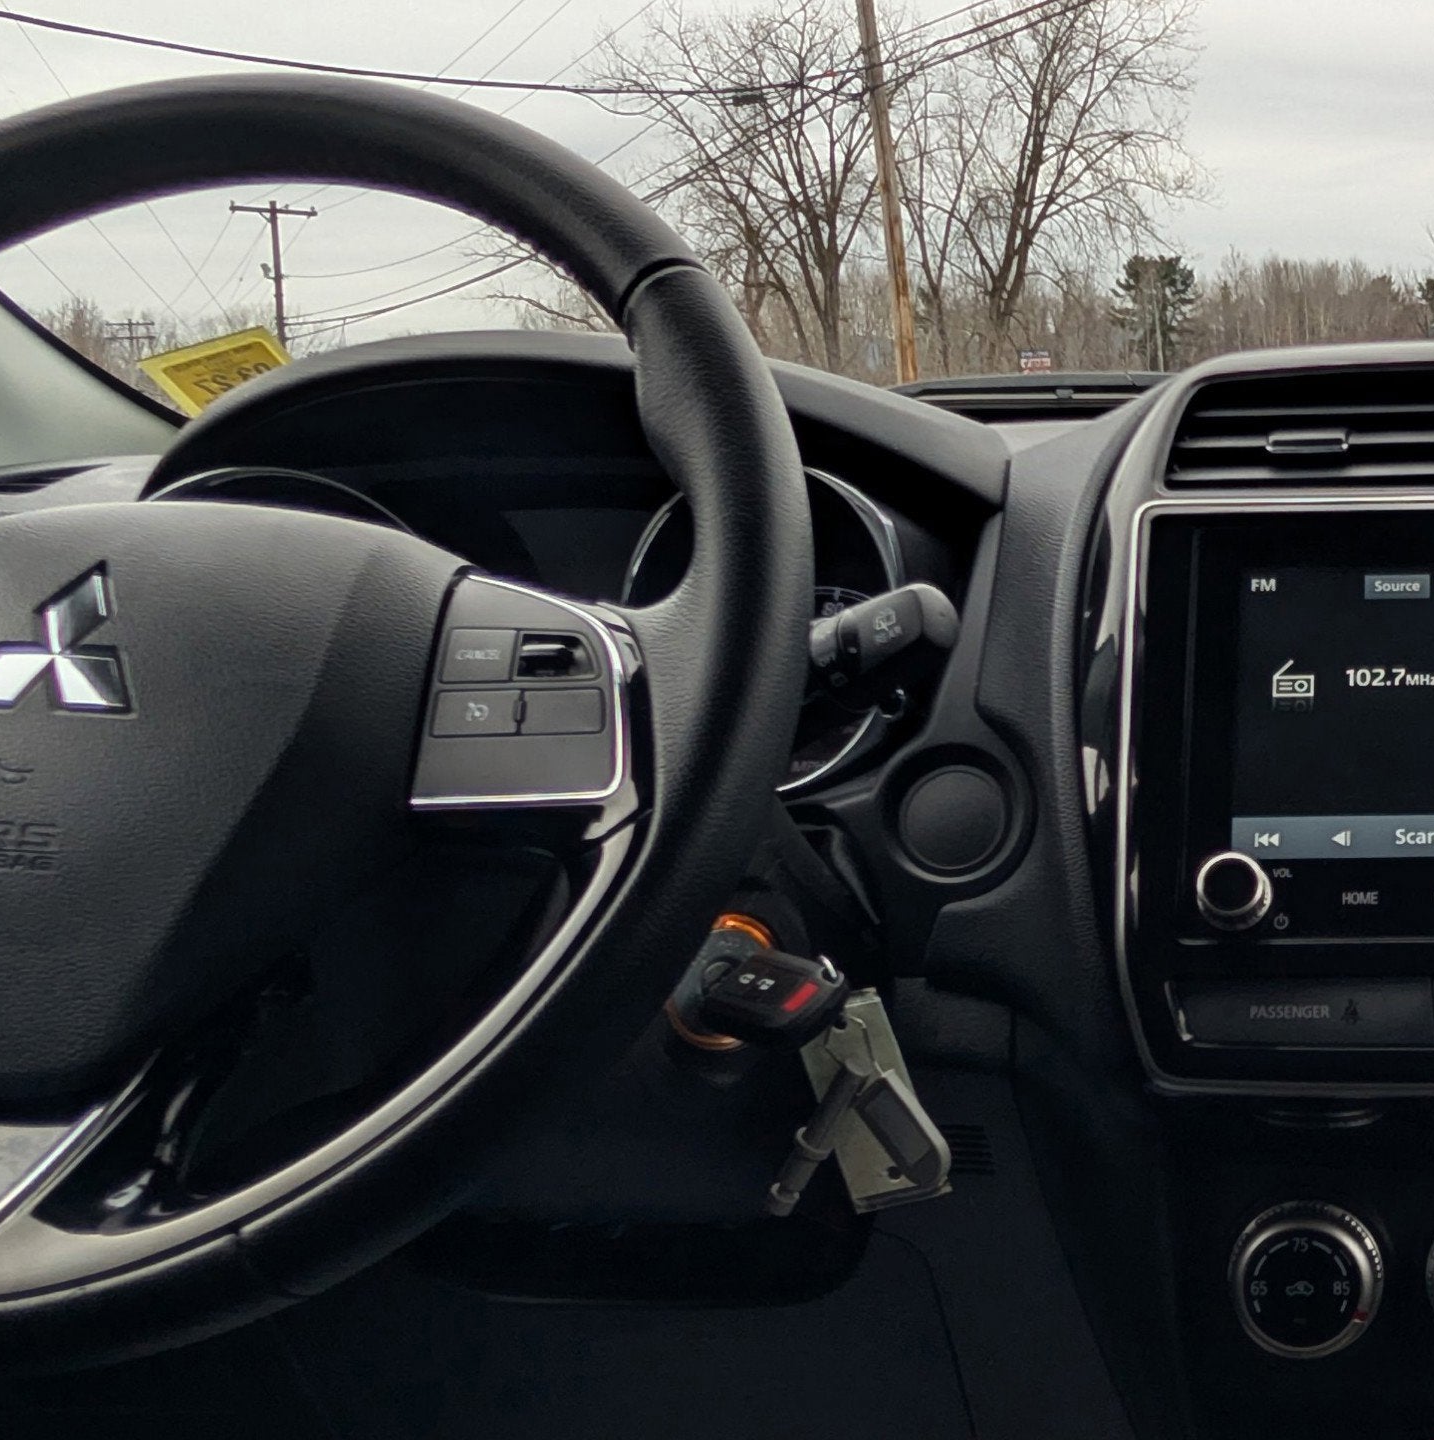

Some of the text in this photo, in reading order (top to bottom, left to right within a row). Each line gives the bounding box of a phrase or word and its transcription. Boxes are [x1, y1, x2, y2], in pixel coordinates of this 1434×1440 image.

[1251, 578, 1277, 592] FM
[1374, 580, 1421, 593] Source
[1272, 867, 1294, 879] VOL
[1341, 891, 1379, 906] HOME
[1249, 1003, 1332, 1020] PASSENGER
[1291, 1237, 1309, 1253] 75
[1250, 1280, 1268, 1297] 65
[1331, 1280, 1351, 1297] 85
